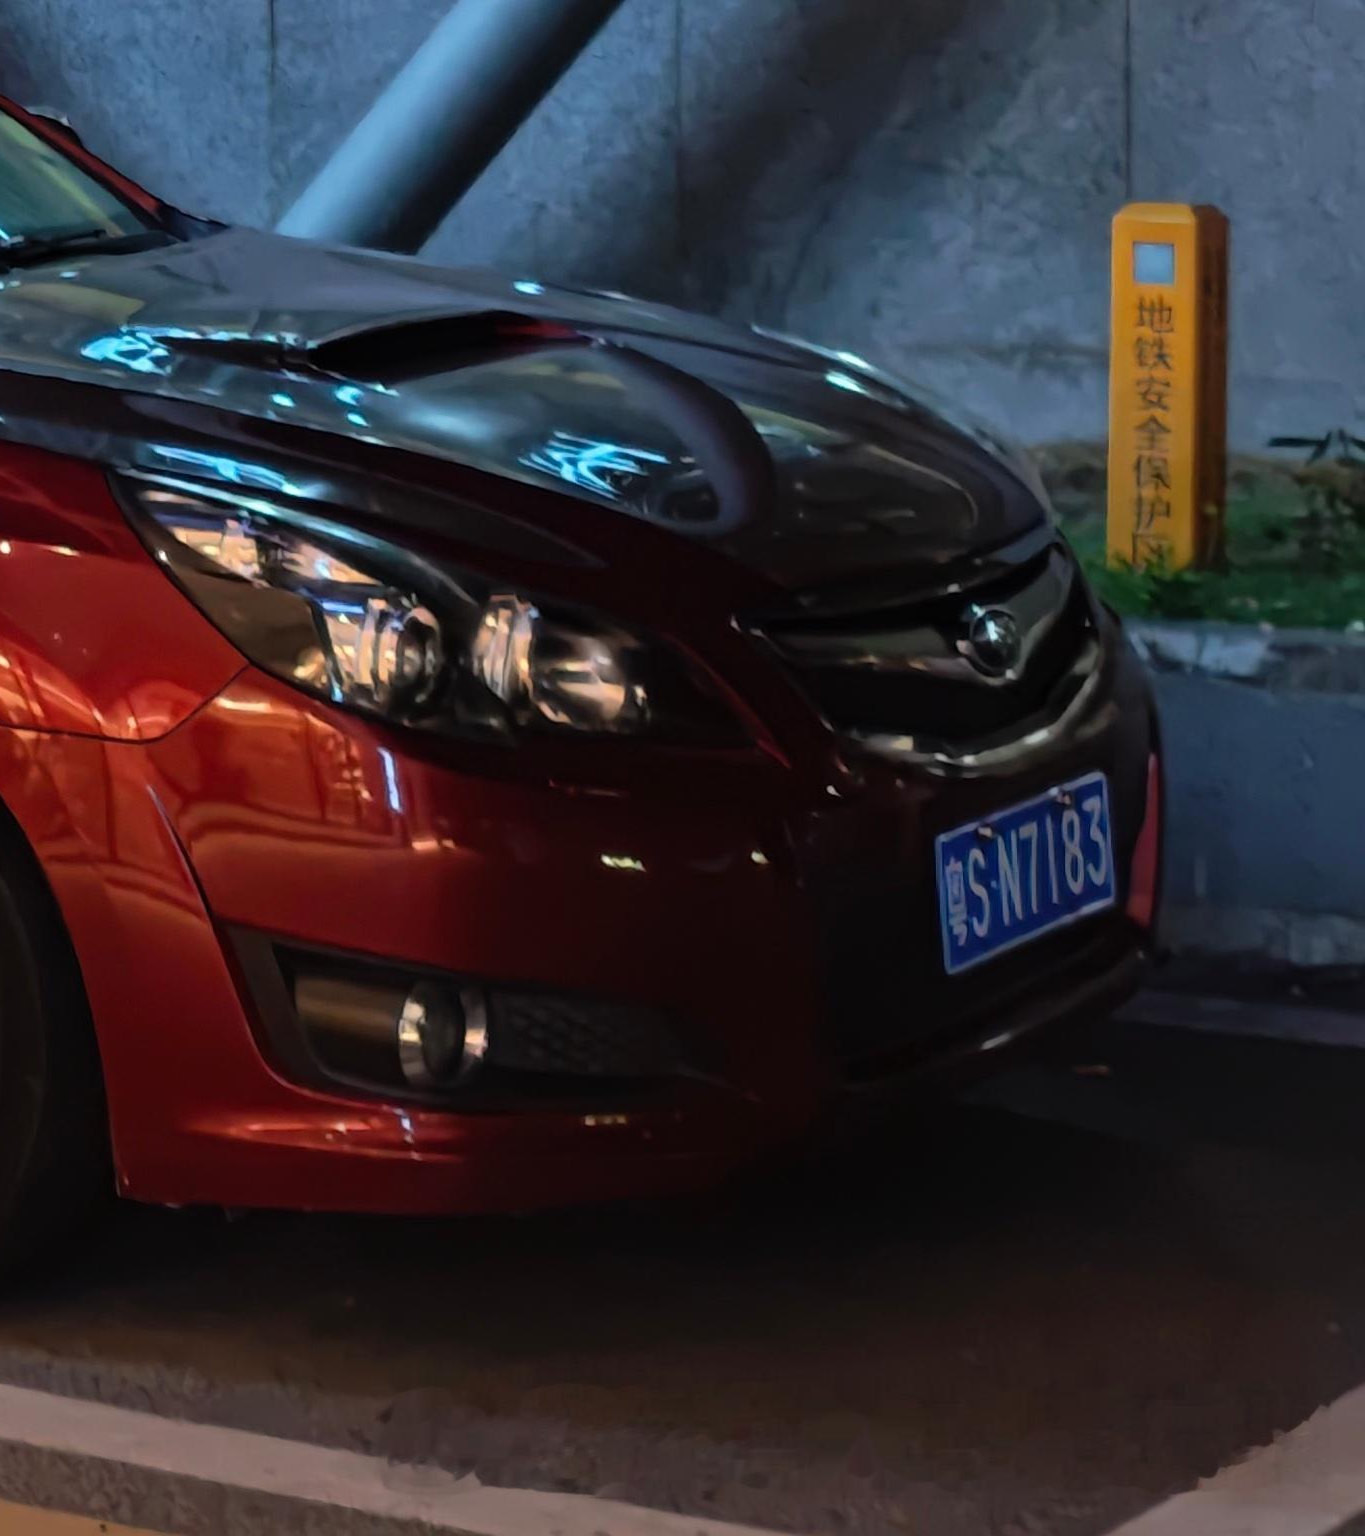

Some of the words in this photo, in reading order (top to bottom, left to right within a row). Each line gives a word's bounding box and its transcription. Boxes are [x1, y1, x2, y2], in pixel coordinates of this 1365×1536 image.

[1131, 296, 1175, 569] 地铁安全保护区
